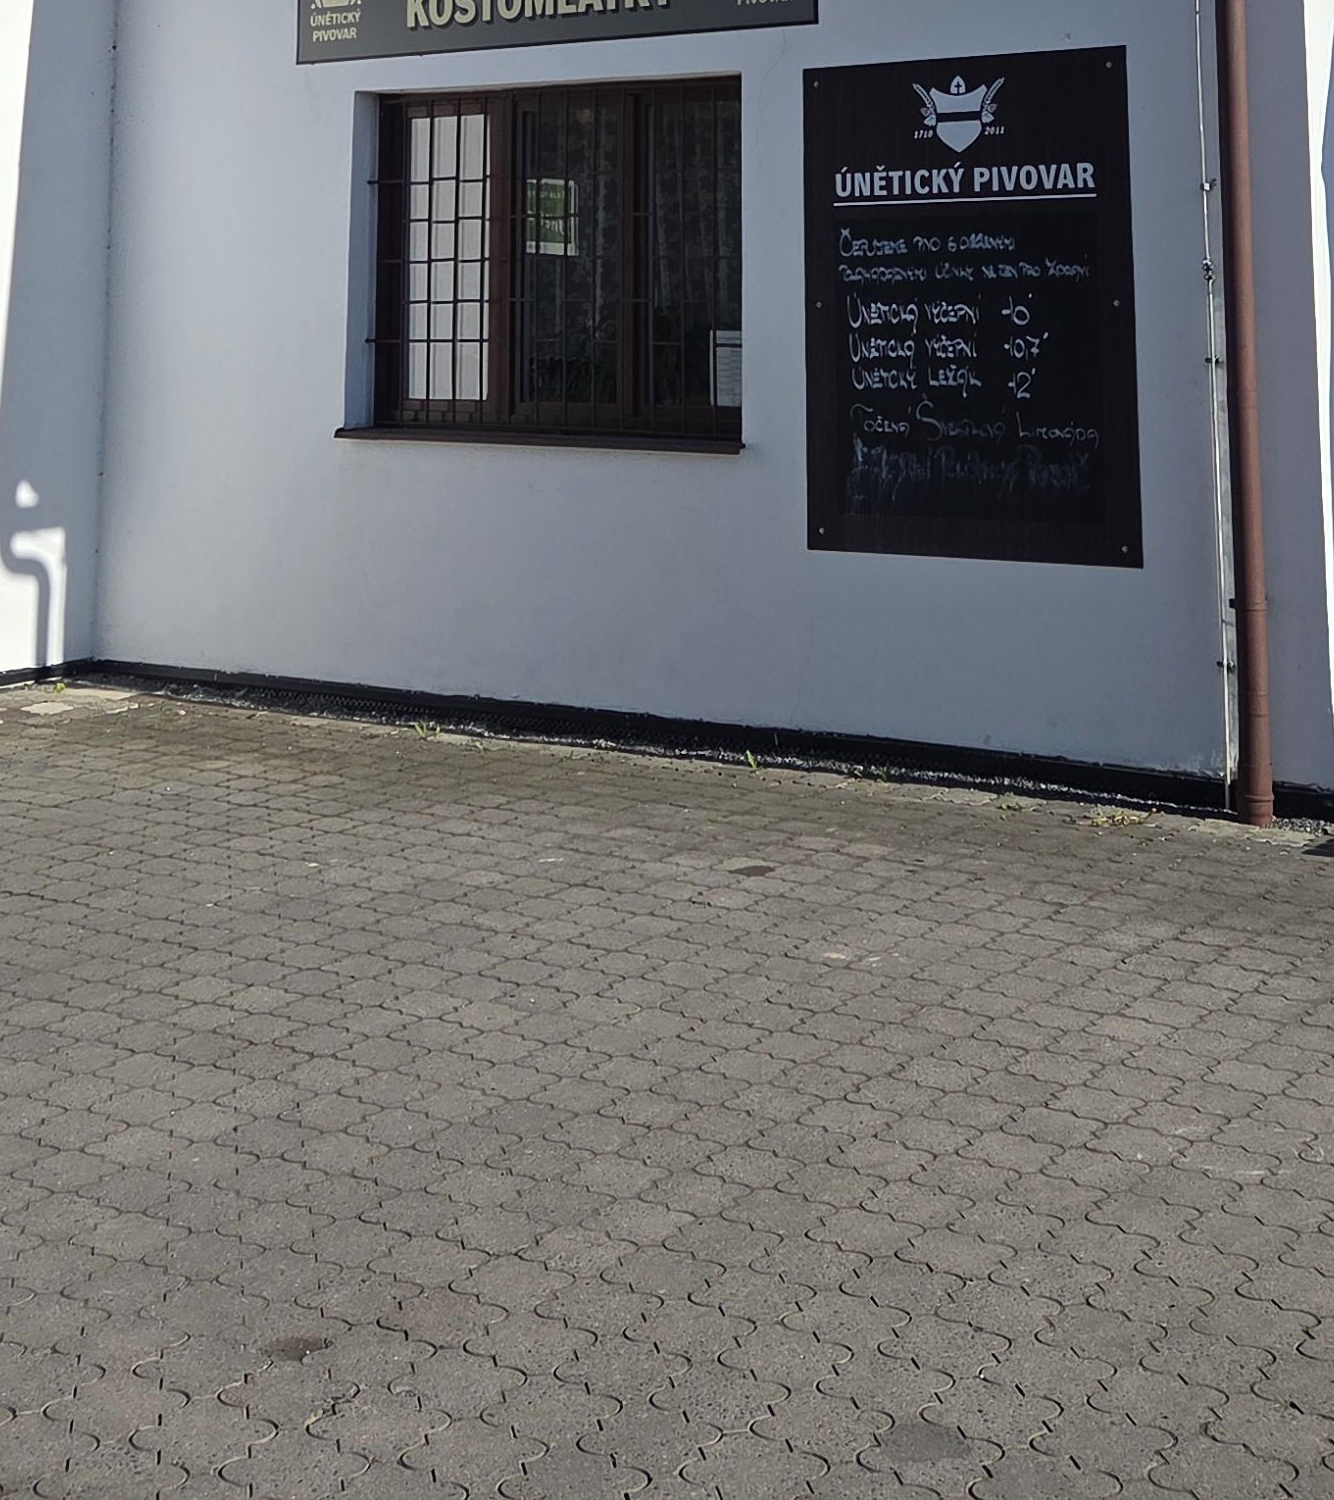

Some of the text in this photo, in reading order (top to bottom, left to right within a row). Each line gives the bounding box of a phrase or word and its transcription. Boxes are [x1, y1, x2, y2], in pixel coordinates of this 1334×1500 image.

[310, 8, 361, 28] ÚNĚTICKÝ
[312, 27, 357, 42] PIVOVAR
[914, 130, 933, 139] 1710
[984, 126, 1004, 135] 2011
[835, 162, 1095, 198] ÚNĚTICKÝ PIVOVAR
[928, 364, 982, 398] LEŽÁK
